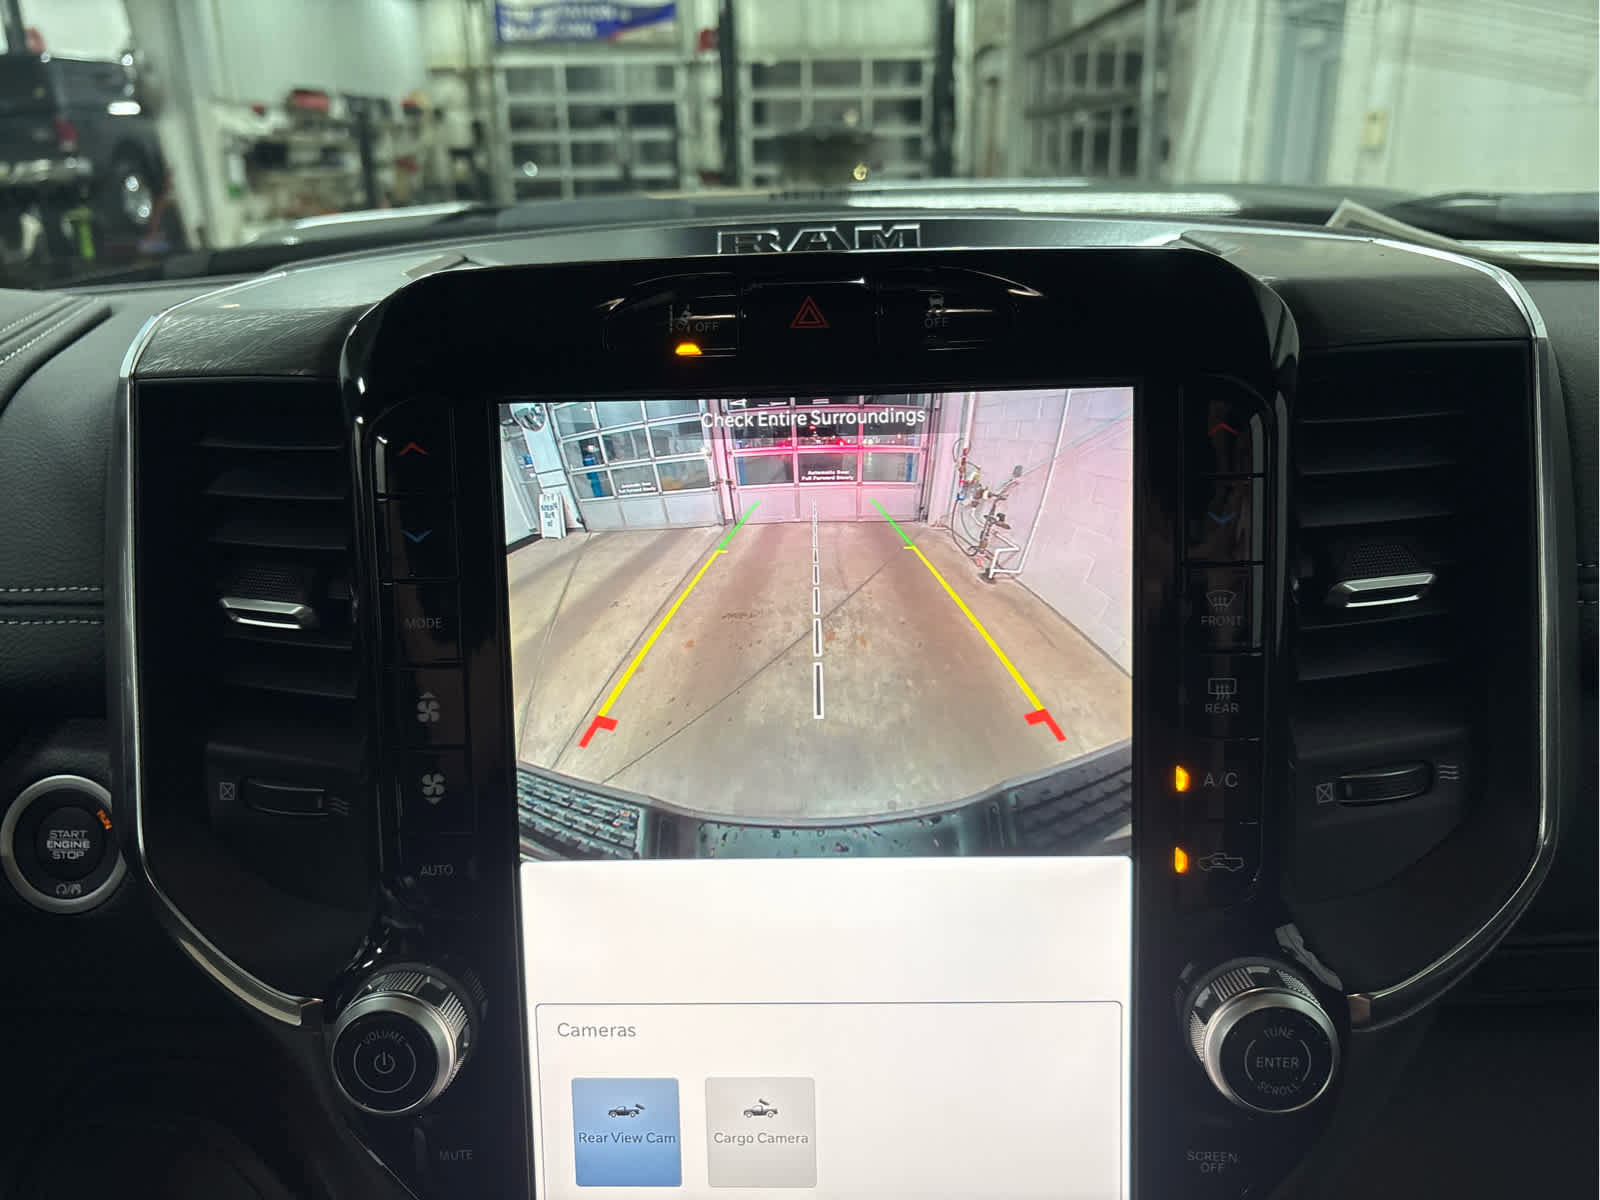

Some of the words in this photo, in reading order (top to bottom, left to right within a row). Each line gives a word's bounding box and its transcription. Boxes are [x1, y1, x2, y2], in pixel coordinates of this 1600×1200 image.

[717, 223, 921, 254] RAM
[695, 320, 720, 333] OFF
[924, 317, 949, 328] OFF
[701, 411, 753, 428] Check
[757, 410, 807, 427] Entire
[810, 407, 926, 428] Surroundings
[405, 617, 442, 629] MODE
[1201, 615, 1243, 627] FRONT
[1205, 703, 1239, 714] REAR
[1203, 772, 1239, 788] A/C
[49, 829, 89, 839] START
[46, 840, 91, 849] ENGINE
[52, 851, 85, 860] STOP
[420, 864, 454, 876] AUTO
[557, 1021, 637, 1038] Cameras
[1264, 1025, 1295, 1040] TUNE
[362, 1029, 406, 1046] VOLUME
[1255, 1056, 1300, 1069] ENTER
[1257, 1081, 1301, 1096] SCROLL
[578, 1132, 608, 1145] Rear
[611, 1132, 643, 1145] View
[646, 1132, 677, 1145] Cam
[713, 1132, 754, 1147] Cargo
[757, 1132, 809, 1145] Camera
[439, 1150, 473, 1161] MUTE
[1187, 1151, 1239, 1163] SCREEN
[1200, 1162, 1225, 1173] OFF
